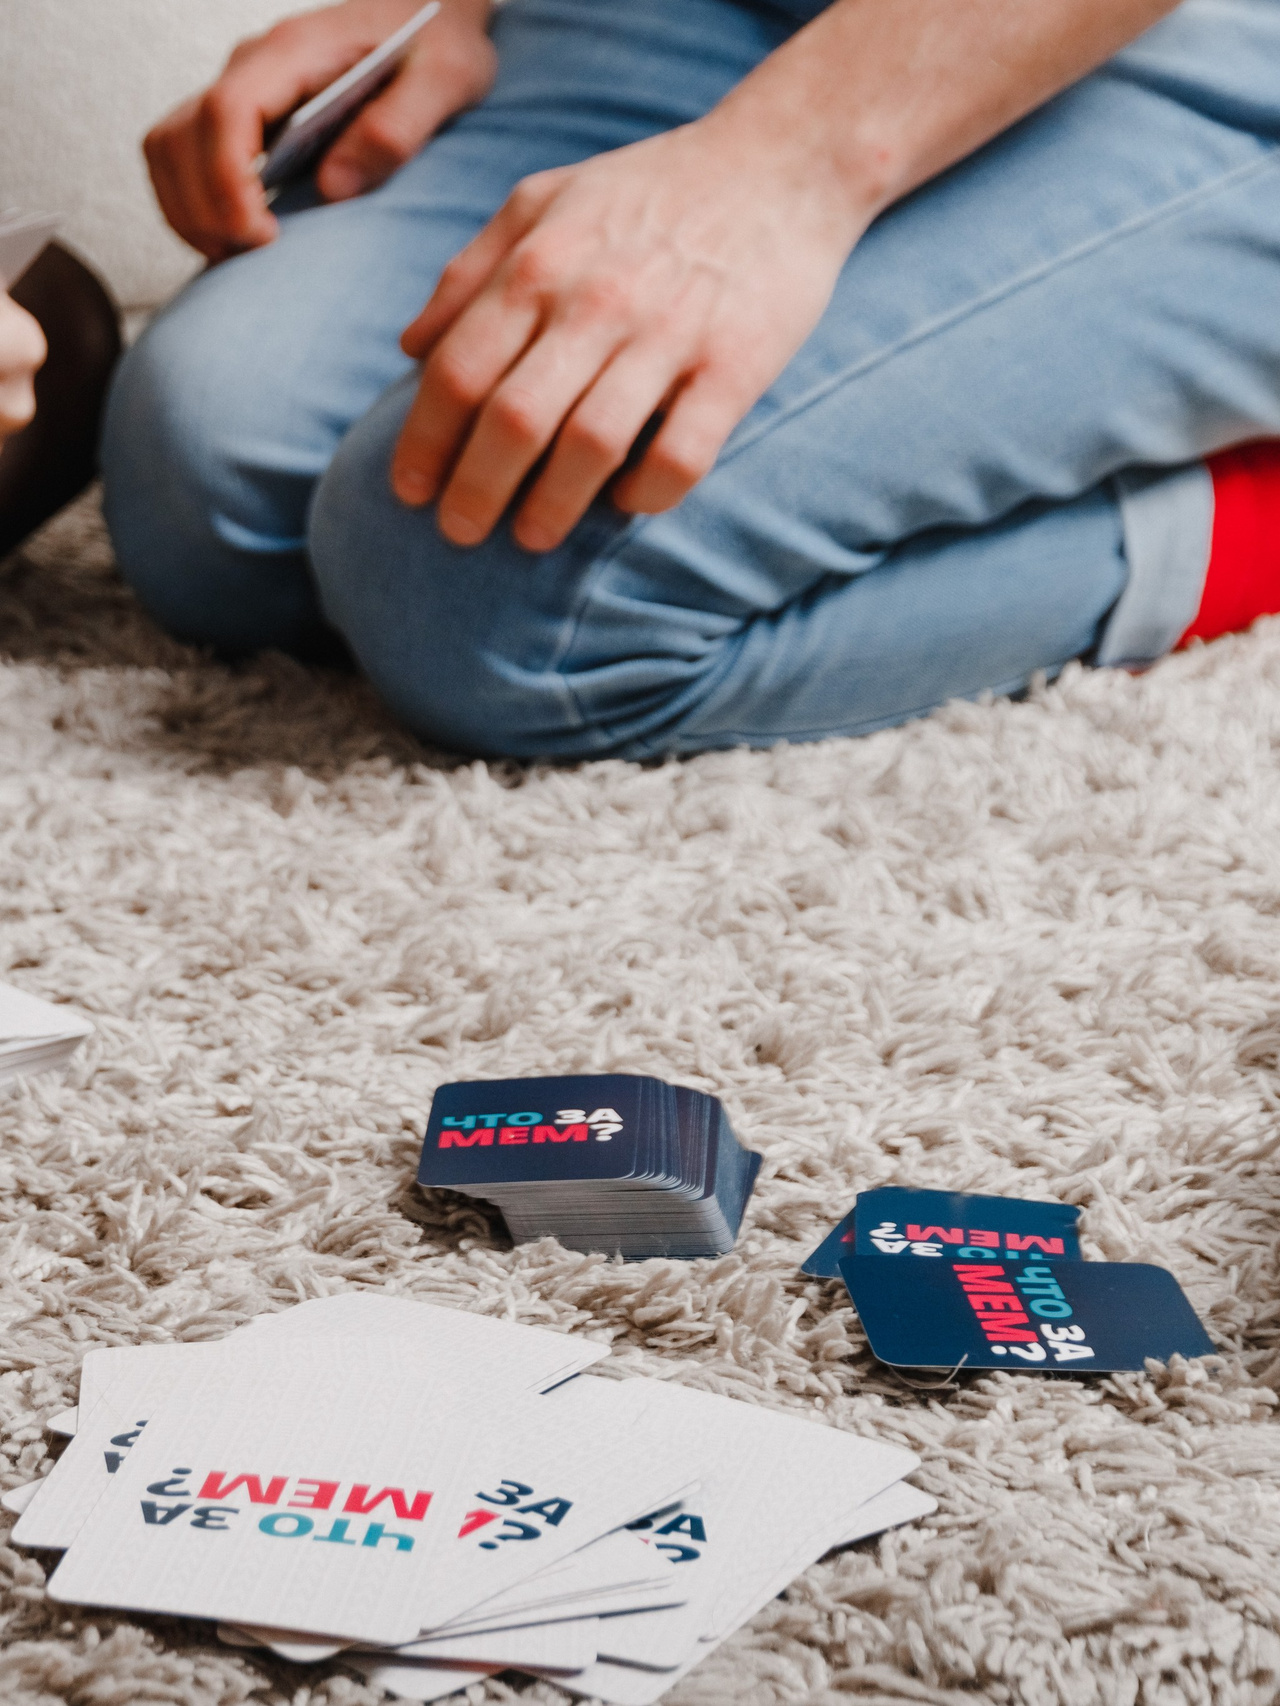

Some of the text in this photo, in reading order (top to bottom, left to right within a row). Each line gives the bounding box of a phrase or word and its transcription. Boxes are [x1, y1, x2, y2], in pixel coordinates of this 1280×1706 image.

[438, 1123, 624, 1149] МЕМ?
[442, 1108, 624, 1129] ЧТО ЗА
[869, 1222, 1065, 1254] МЕМ?
[870, 1238, 944, 1257] ЗА
[952, 1264, 1048, 1361] МЕМ?
[1015, 1266, 1096, 1362] ЧТО ЗА
[146, 1467, 435, 1522] МЕМ?
[475, 1479, 574, 1527] ЗА
[140, 1500, 416, 1552] ЧТО ЗА
